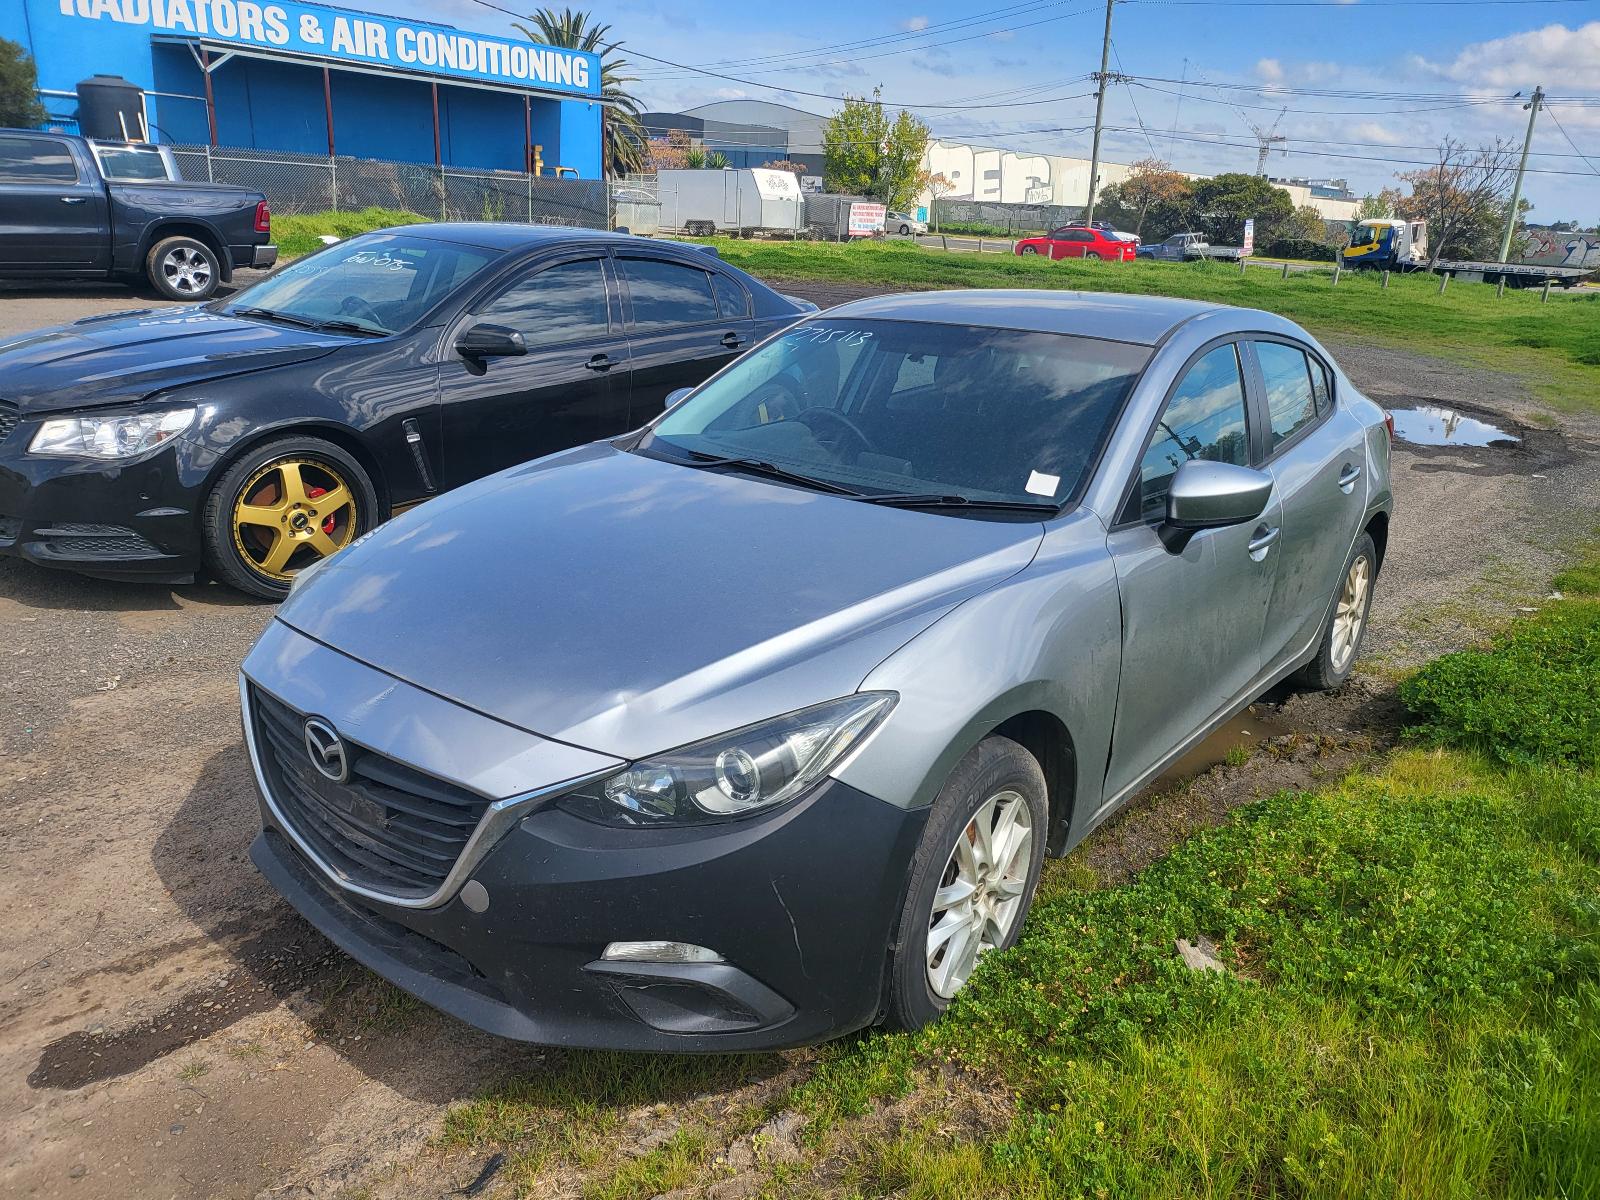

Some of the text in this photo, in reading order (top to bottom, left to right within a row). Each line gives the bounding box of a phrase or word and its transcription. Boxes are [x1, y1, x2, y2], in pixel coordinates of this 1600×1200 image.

[299, 14, 324, 45] &
[331, 17, 389, 60] AIR
[395, 27, 589, 88] CONDITIONING
